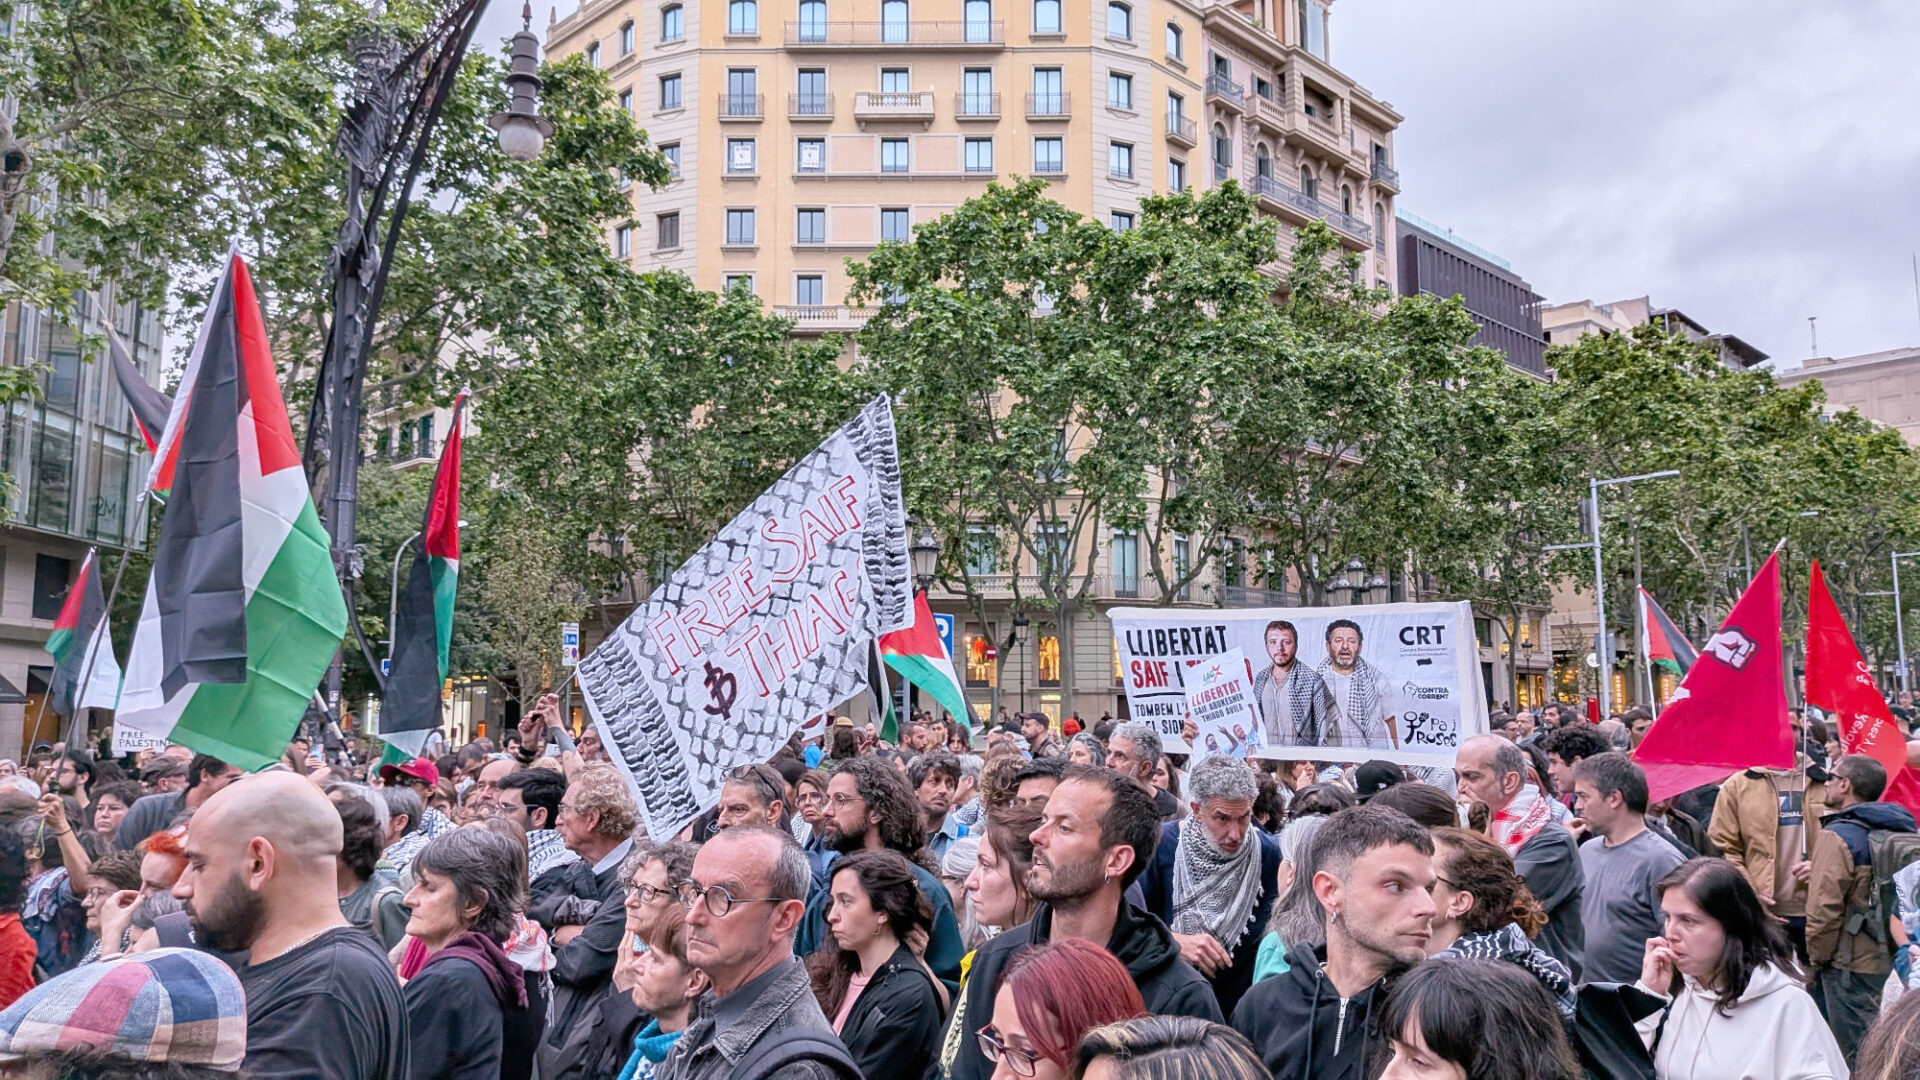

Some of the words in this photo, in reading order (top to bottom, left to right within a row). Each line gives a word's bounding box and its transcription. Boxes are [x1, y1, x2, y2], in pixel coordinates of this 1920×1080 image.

[646, 557, 771, 676] FREE
[761, 475, 860, 583] SAIF
[725, 566, 857, 697] THIAG
[1126, 625, 1227, 656] LLIBERTAT
[1399, 625, 1446, 646] CRT
[1130, 659, 1169, 689] SAIF
[1192, 679, 1241, 707] LLIBERTAT
[1134, 702, 1174, 717] TOMBEM
[1193, 704, 1208, 716] SAIF
[1201, 709, 1225, 723] THIAGO
[120, 730, 146, 739] FREE
[1161, 720, 1185, 735] SION
[119, 738, 168, 748] PALESTIN
